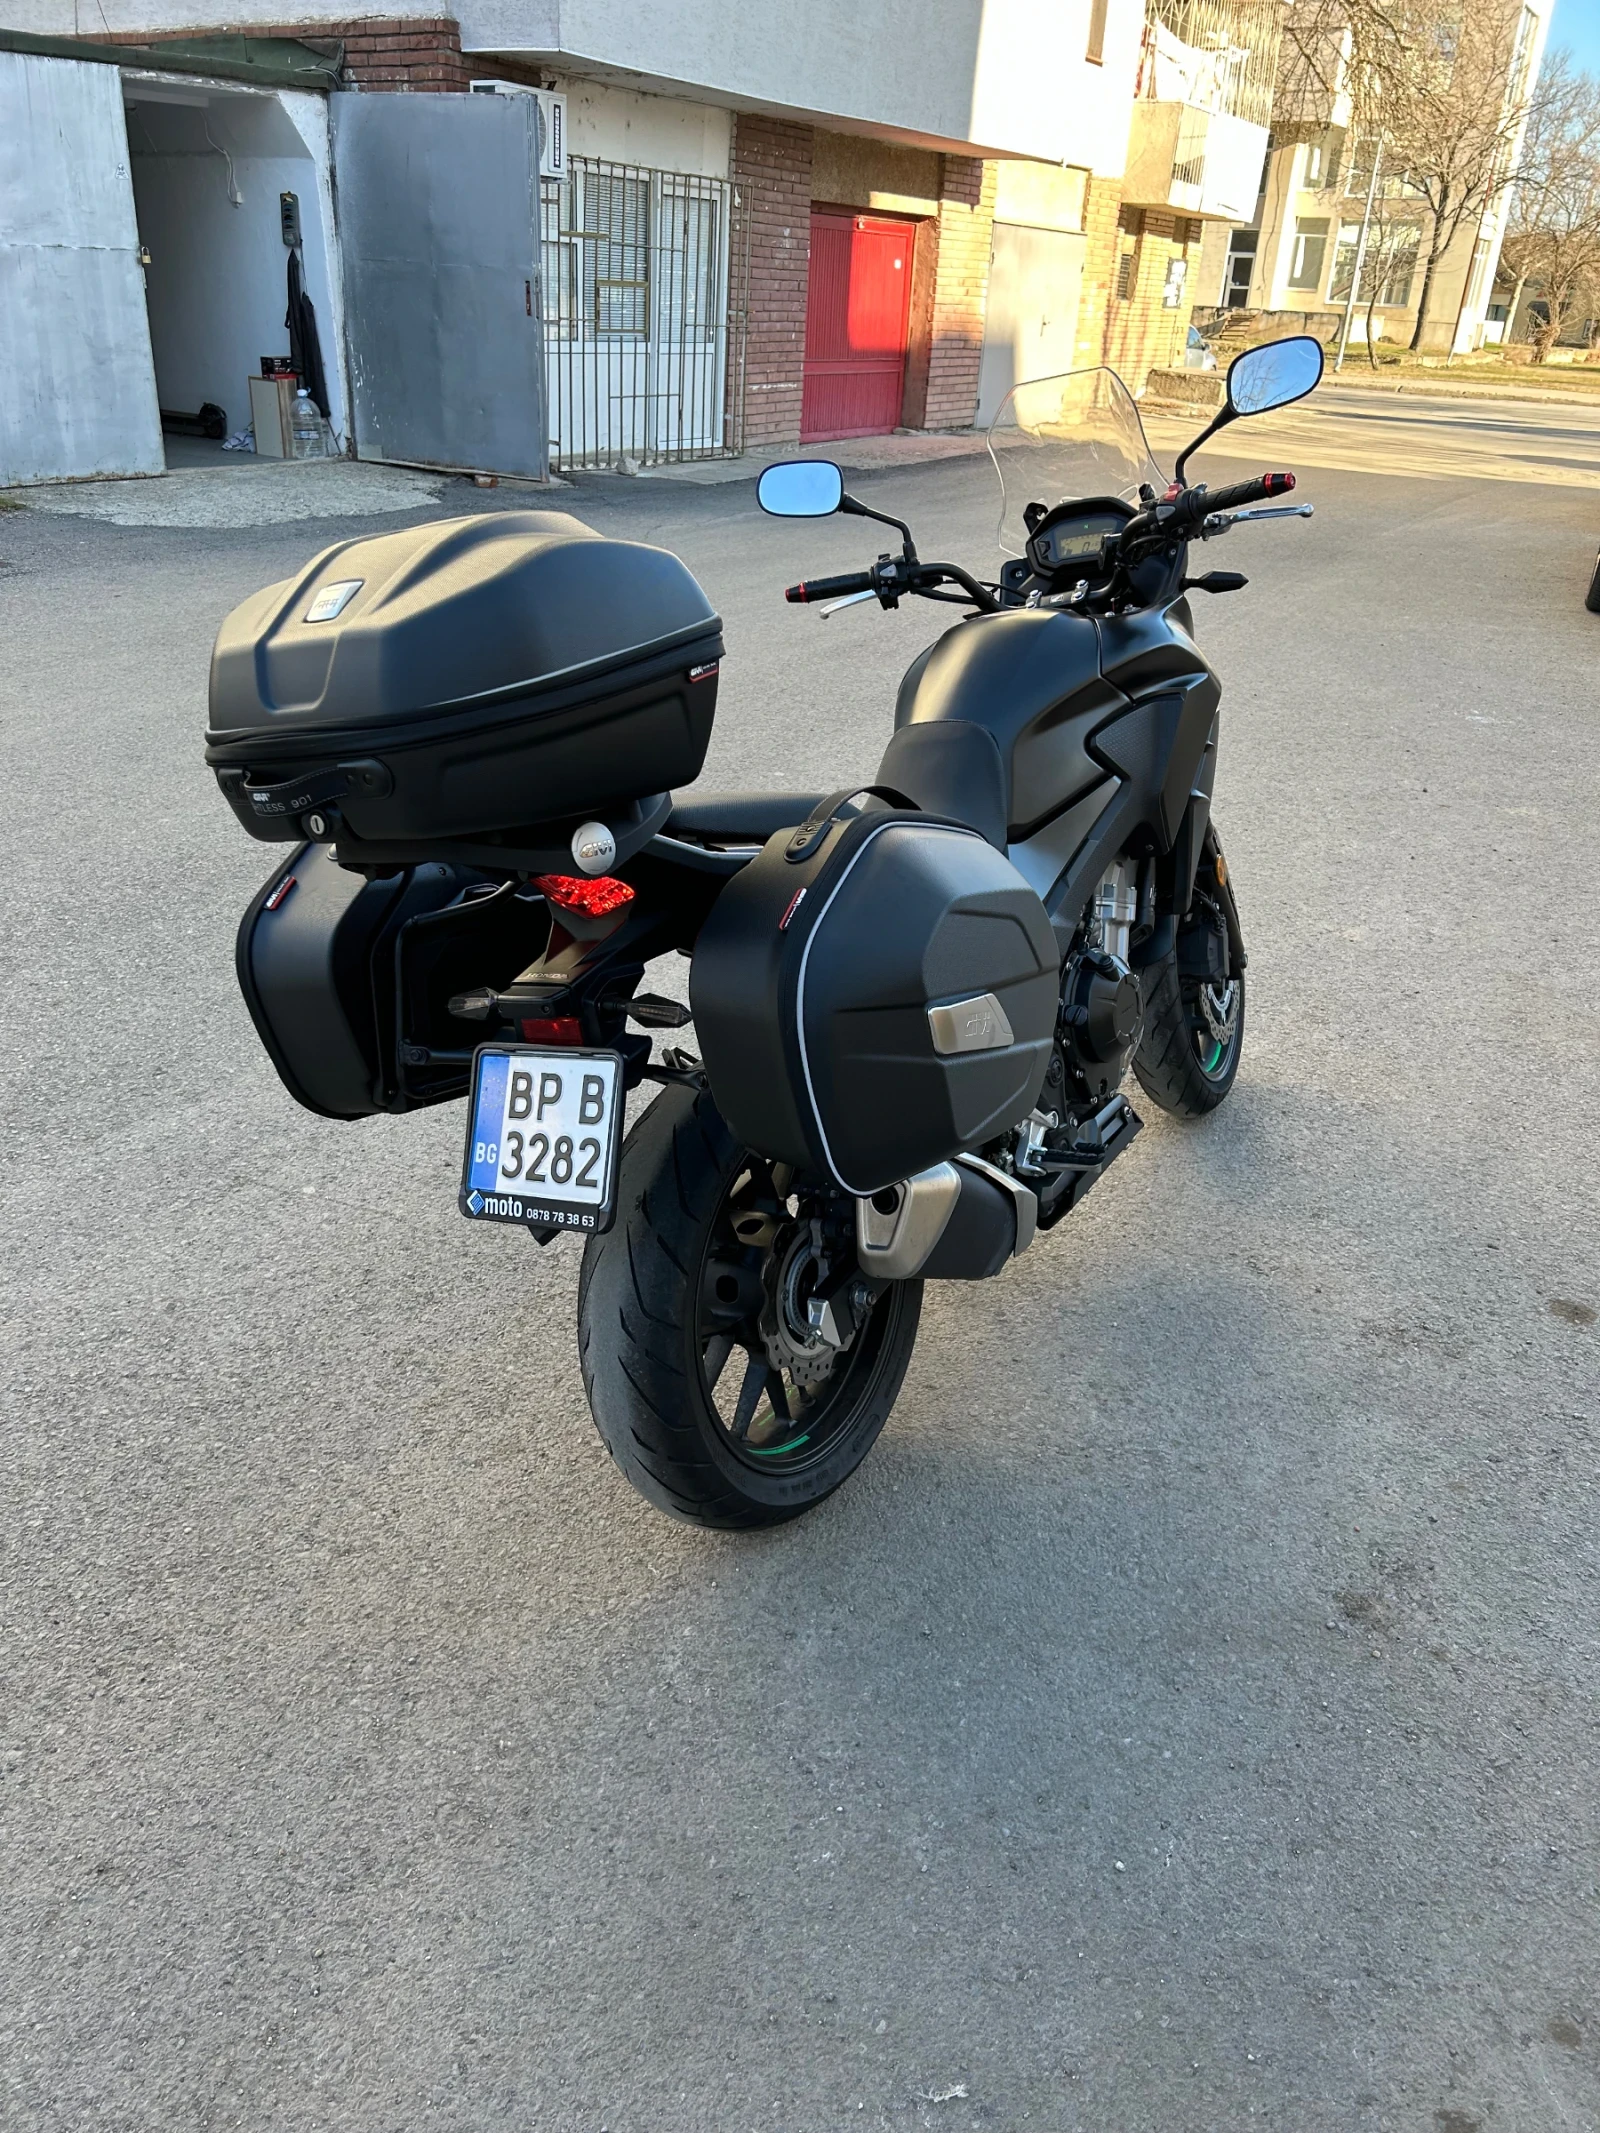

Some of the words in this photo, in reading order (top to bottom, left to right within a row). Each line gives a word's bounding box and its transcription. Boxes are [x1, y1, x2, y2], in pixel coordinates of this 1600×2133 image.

[291, 794, 313, 809] 901
[579, 839, 612, 858] GIVI
[508, 1071, 563, 1121] BP
[579, 1074, 605, 1125] B
[474, 1142, 498, 1164] BG
[501, 1130, 600, 1188] 3282
[485, 1196, 523, 1218] moto
[526, 1208, 550, 1221] 0878
[552, 1211, 565, 1223] 78
[566, 1213, 579, 1225] 38
[581, 1216, 594, 1228] 63
